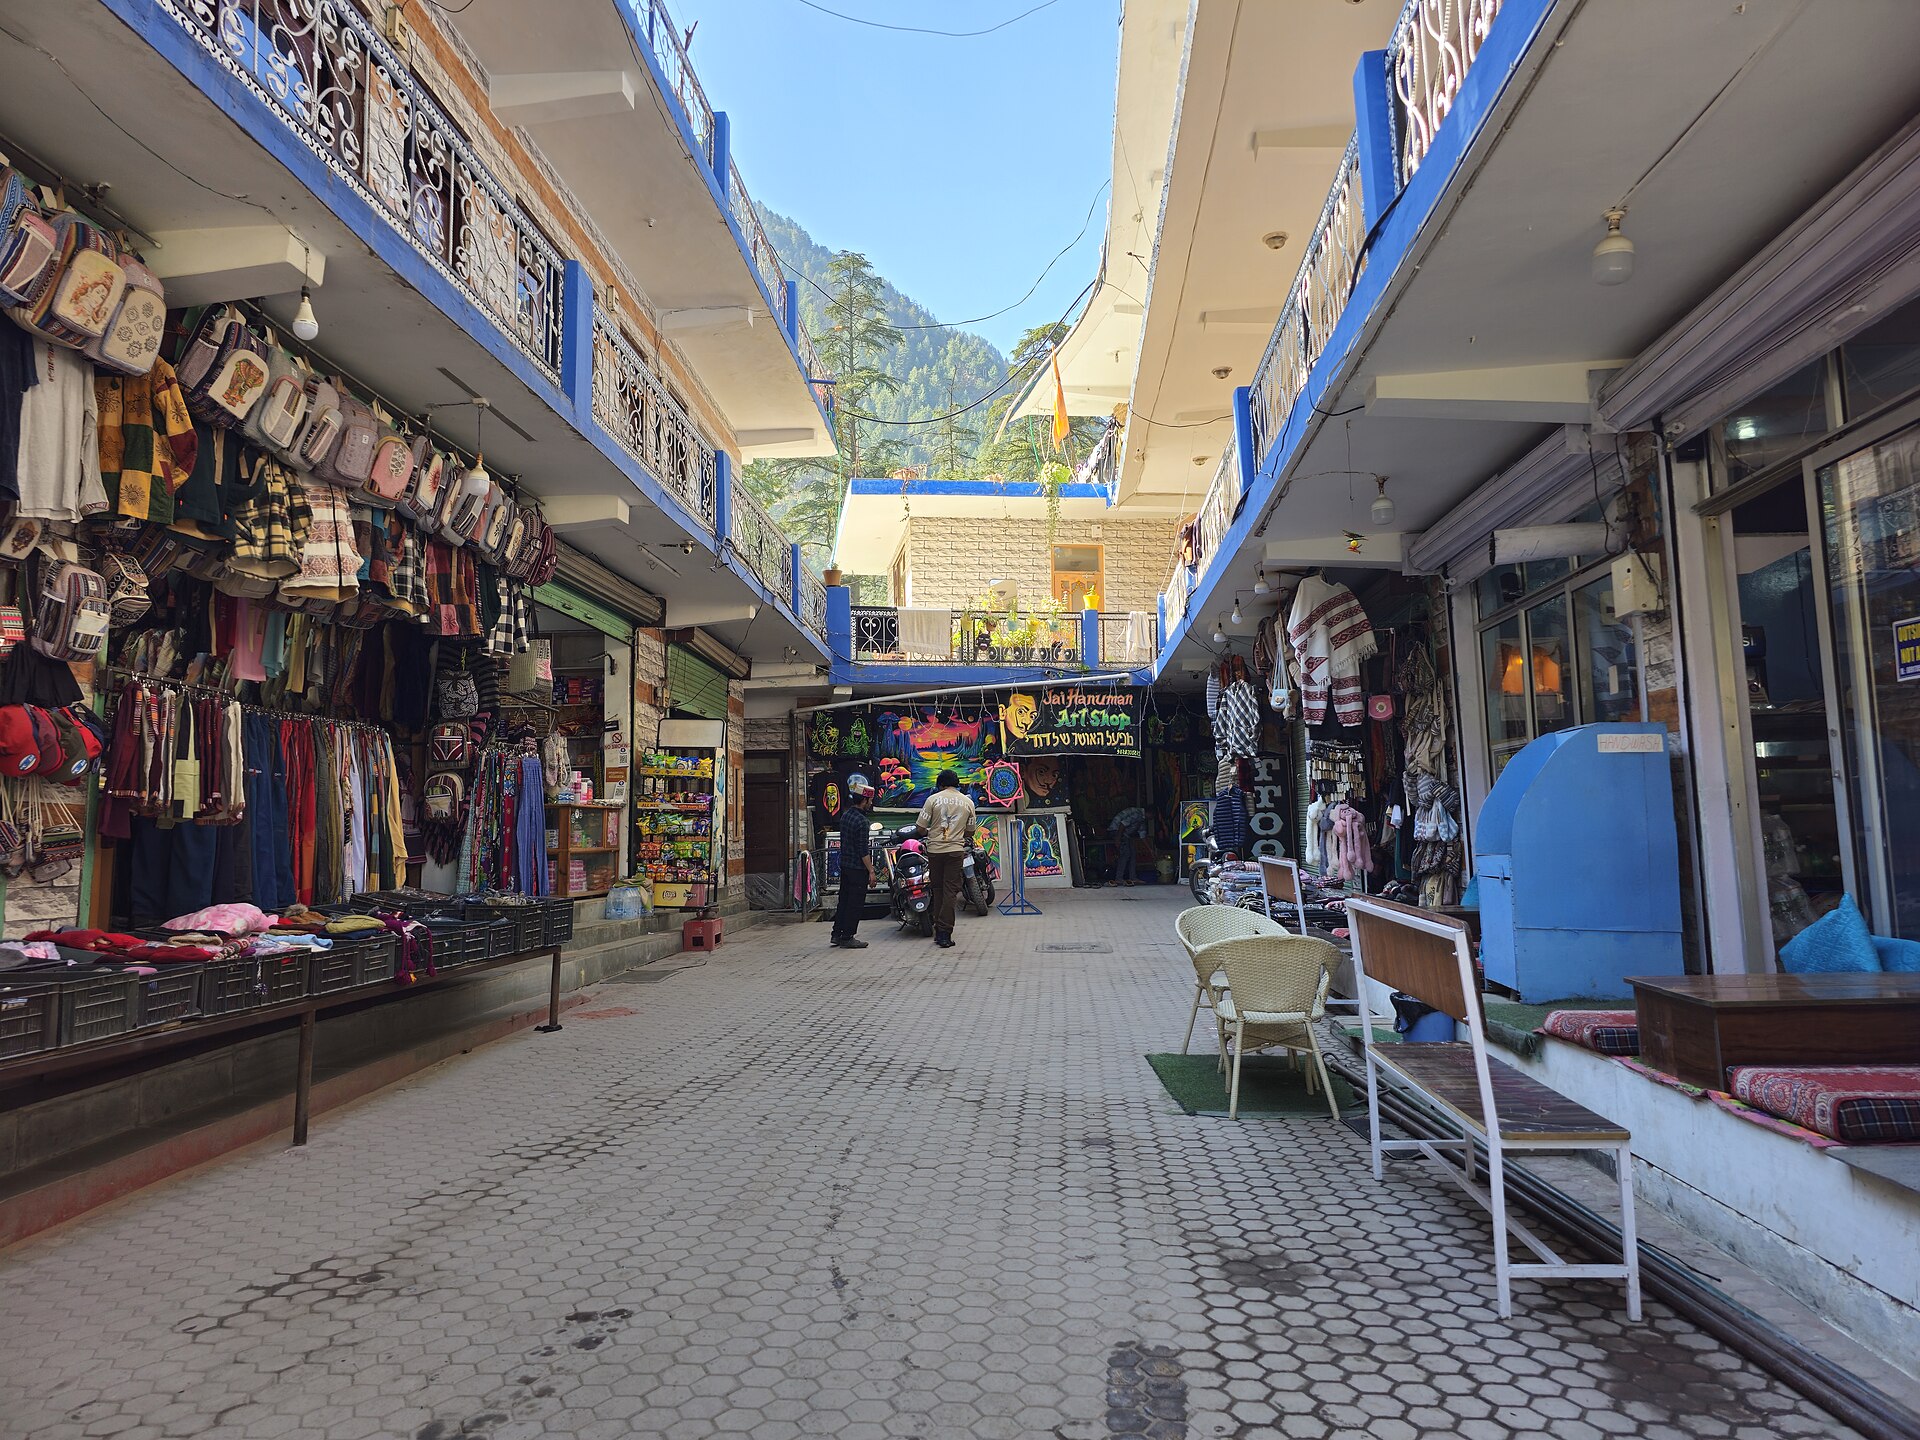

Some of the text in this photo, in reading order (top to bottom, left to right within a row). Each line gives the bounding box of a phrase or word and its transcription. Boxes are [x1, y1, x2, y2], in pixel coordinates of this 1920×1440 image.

[1043, 688, 1134, 708] Jai Hanuman
[1054, 708, 1131, 731] Art Shop
[1600, 735, 1661, 751] HANDWASH
